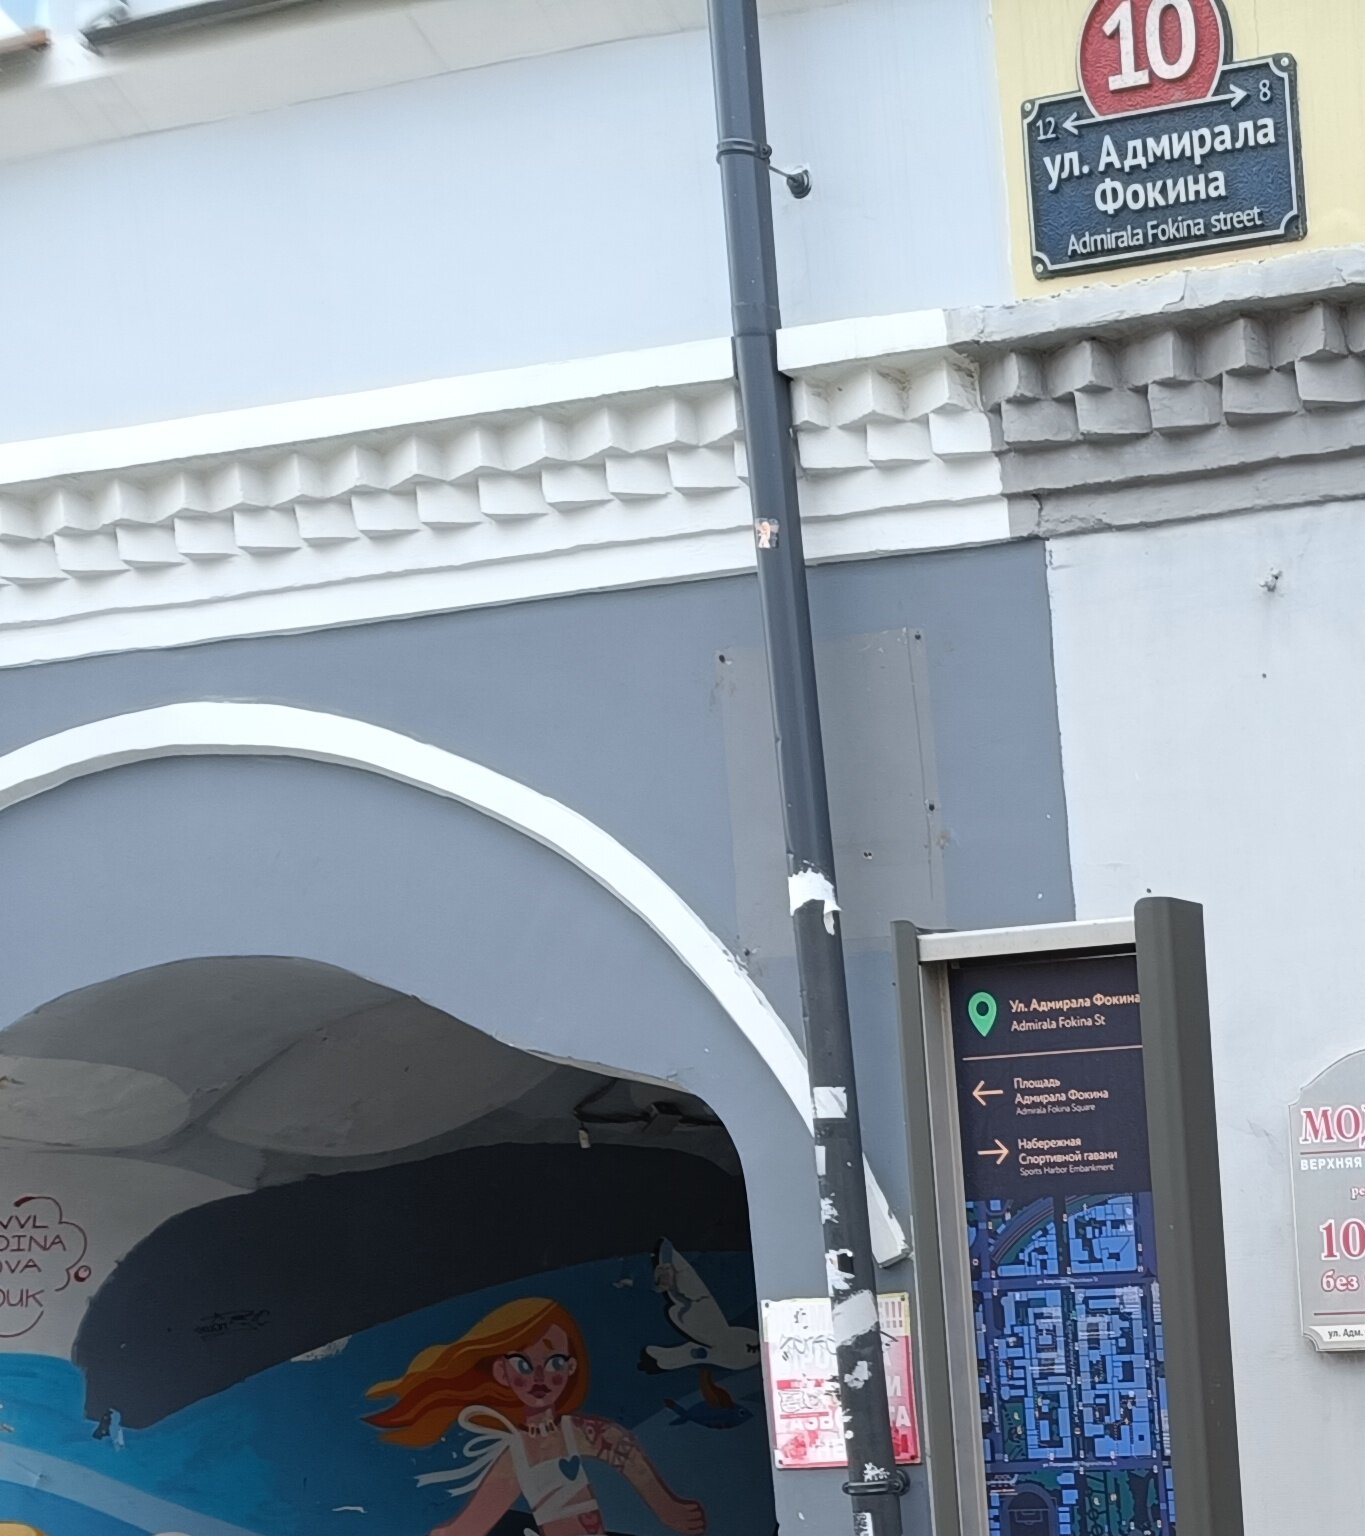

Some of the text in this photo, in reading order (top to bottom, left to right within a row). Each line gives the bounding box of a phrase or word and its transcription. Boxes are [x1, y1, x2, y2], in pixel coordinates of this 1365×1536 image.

[1102, 0, 1196, 91] 10
[1258, 79, 1272, 102] 8
[1035, 117, 1057, 141] 12
[1043, 117, 1276, 190] ул. Адмирала
[1094, 169, 1227, 214] Фокина
[1067, 206, 1263, 256] Admirala Fokina street
[1009, 993, 1140, 1013] Ул. Адмирала Фокина
[1010, 1013, 1106, 1032] Admirala Fokina St
[1013, 1077, 1061, 1089] Площадь
[1014, 1089, 1109, 1105] Адмирала Фокина
[1017, 1137, 1081, 1151] Набережная
[1018, 1150, 1118, 1166] Спортивной гавани
[1300, 1156, 1363, 1171] ВЕРХНЯЯ
[0, 1259, 42, 1274] VA
[1321, 1269, 1360, 1292] без
[1327, 1330, 1341, 1339] ул.
[1343, 1329, 1363, 1338] Адм.
